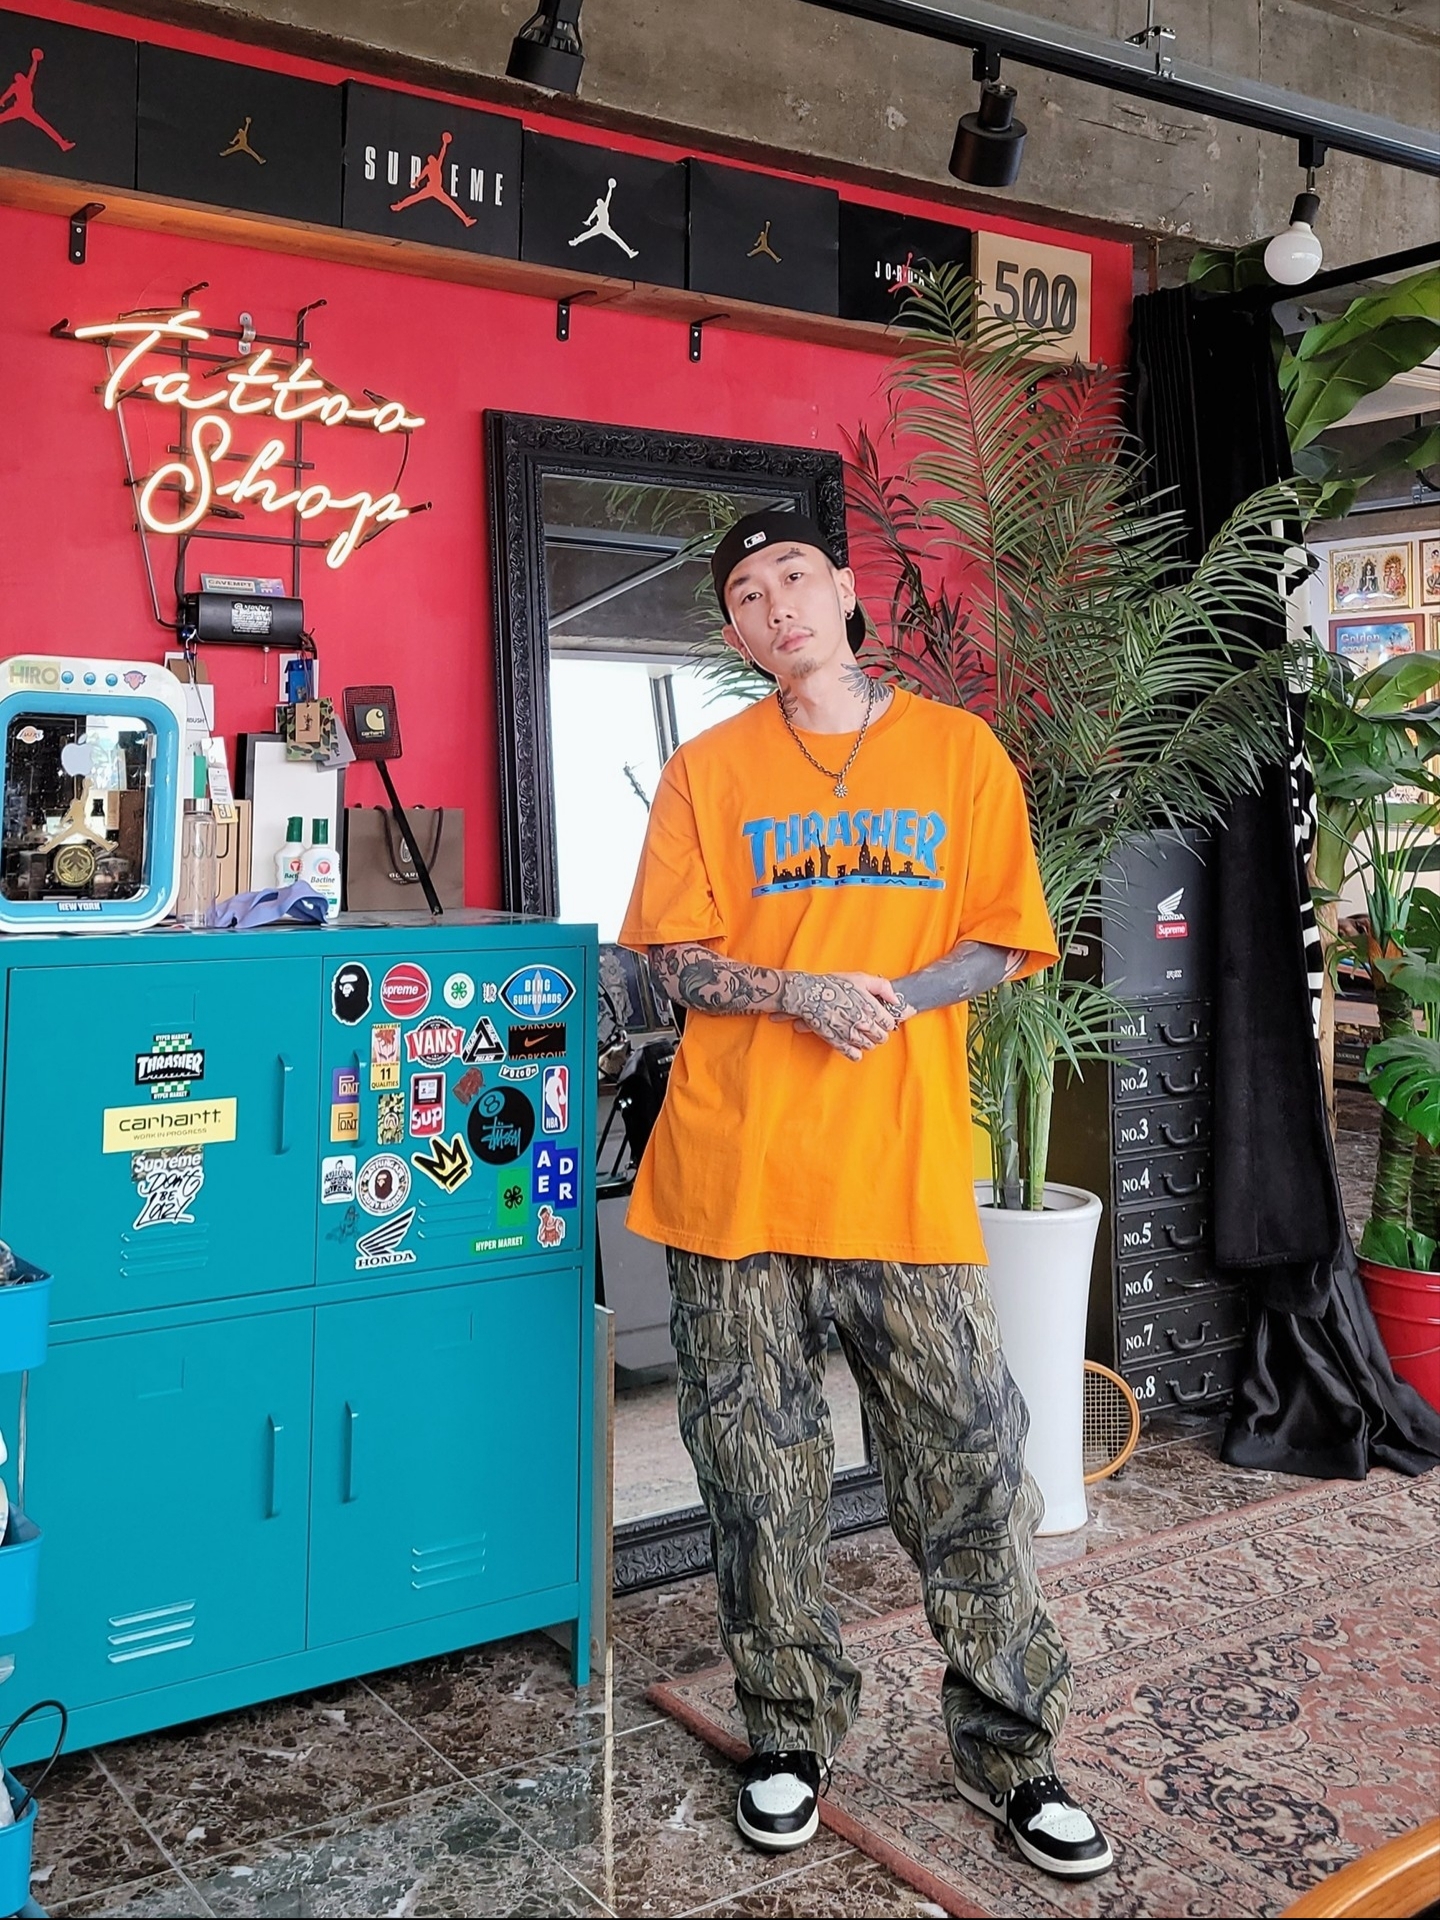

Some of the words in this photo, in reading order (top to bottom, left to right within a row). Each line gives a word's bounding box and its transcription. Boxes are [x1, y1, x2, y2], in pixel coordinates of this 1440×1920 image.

[364, 146, 504, 206] SUPEME
[993, 260, 1078, 335] 500
[75, 310, 425, 432] Tattoo
[140, 415, 409, 568] Shop
[1340, 631, 1380, 644] Golden
[9, 664, 59, 686] HIRO
[742, 808, 947, 883] THRASHER
[310, 876, 336, 884] Bactine
[759, 876, 930, 894] SUPREME
[59, 902, 77, 911] NEW
[78, 902, 101, 911] YORK
[1157, 913, 1185, 921] HONDA
[1158, 924, 1186, 937] Supreme
[524, 978, 551, 992] BING
[513, 993, 562, 1005] SURFBOARDS
[1120, 1015, 1147, 1037] NO.1
[412, 1029, 457, 1056] VANS
[137, 1052, 204, 1078] THRASHER
[380, 1067, 391, 1080] 11
[371, 1081, 399, 1089] QUALITIES
[1120, 1067, 1148, 1092] NO.2
[119, 1108, 222, 1132] carhartt
[546, 1117, 559, 1129] NBA
[1121, 1118, 1149, 1142] NO.3
[166, 1128, 207, 1136] PROGRESS
[134, 1153, 202, 1172] Supreme
[1122, 1167, 1150, 1193] NO.4
[160, 1190, 177, 1201] BE
[475, 1239, 497, 1251] HYPER
[497, 1236, 523, 1248] MARKET
[1123, 1222, 1152, 1247] NO.5
[358, 1252, 414, 1268] HONDA
[1125, 1270, 1153, 1296] NO.6
[1126, 1323, 1153, 1351] NO.7
